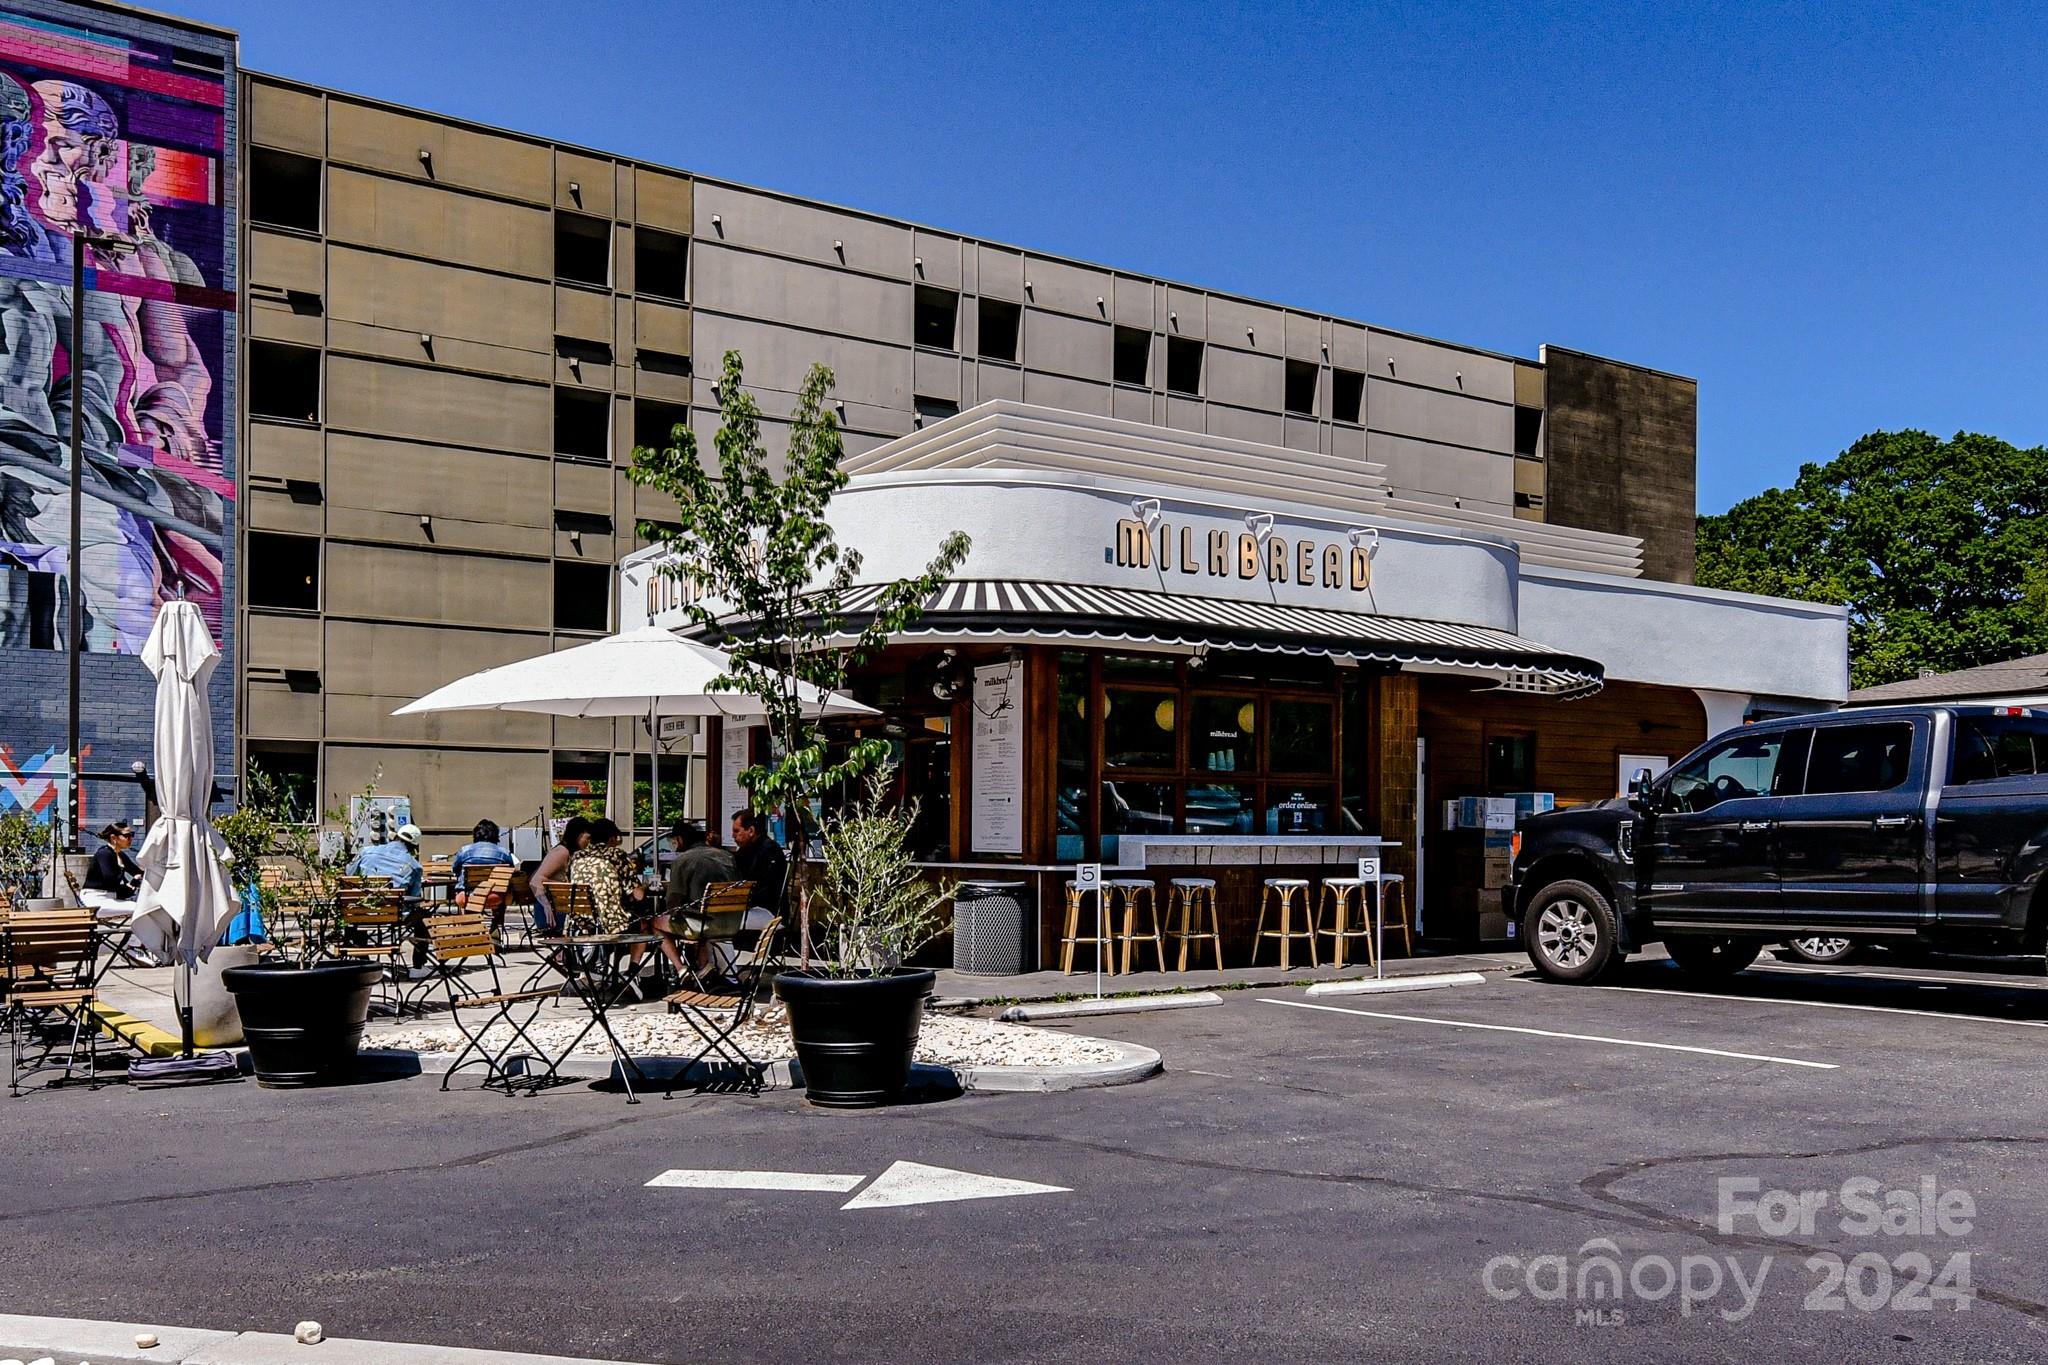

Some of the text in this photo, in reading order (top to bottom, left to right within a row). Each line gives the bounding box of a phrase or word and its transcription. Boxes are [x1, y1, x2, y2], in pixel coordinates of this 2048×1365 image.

[1116, 518, 1371, 591] MILKBREAD
[984, 674, 1013, 687] milkbre
[1209, 730, 1238, 738] milkbread
[1278, 801, 1318, 809] order online
[1081, 865, 1095, 882] 5
[1363, 860, 1375, 875] 5
